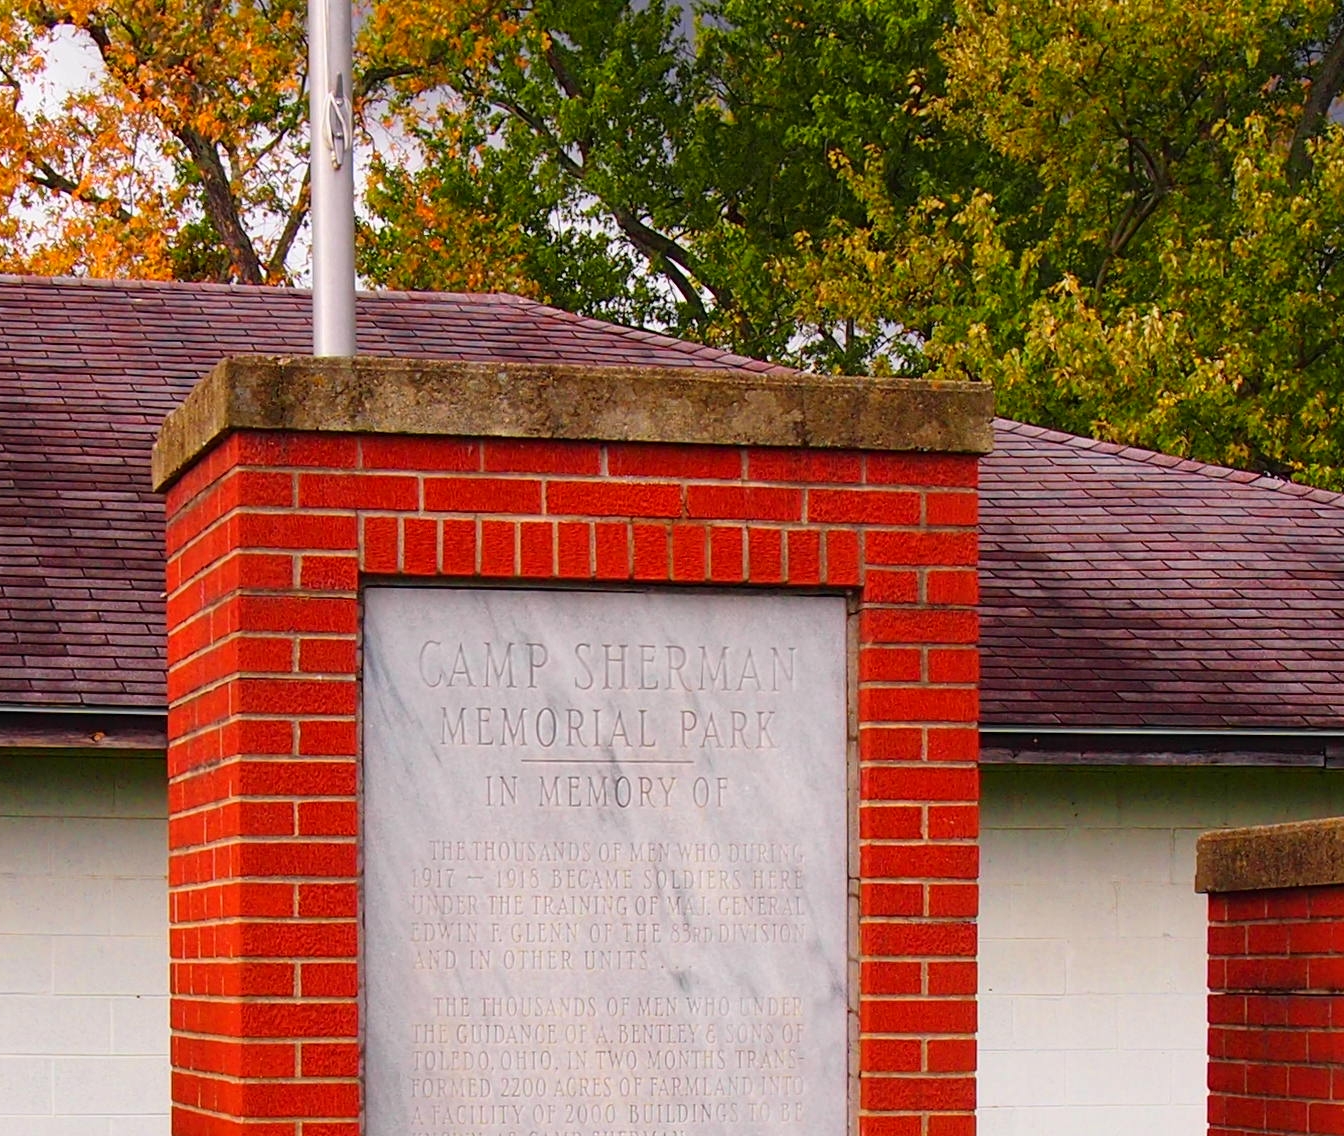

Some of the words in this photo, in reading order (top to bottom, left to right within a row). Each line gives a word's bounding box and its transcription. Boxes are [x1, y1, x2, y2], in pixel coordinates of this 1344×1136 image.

[419, 640, 549, 690] CAMP
[574, 642, 797, 693] SHERMAN
[440, 707, 657, 749] MEMORIAL
[679, 709, 779, 750] PARK
[484, 776, 518, 807] IN
[538, 776, 677, 808] MEMORY
[693, 777, 728, 808] OF
[429, 841, 466, 861] THE
[473, 841, 591, 862] THOUSANDS
[599, 843, 621, 862] OF
[630, 842, 669, 862] MEN
[677, 843, 720, 862] WHO
[728, 843, 804, 864] DURING
[412, 868, 455, 888] 1917
[496, 868, 540, 889] 1918
[552, 868, 632, 889] BECAME
[644, 870, 742, 890] SOLDIERS
[753, 870, 804, 889] HERE
[412, 895, 478, 915] UNDER
[489, 896, 524, 915] THE
[532, 896, 627, 915] TRAINING
[635, 896, 658, 915] OF
[667, 896, 711, 916] MAJ.
[718, 896, 805, 916] GENERAL
[410, 923, 478, 943] EDWIN
[492, 923, 502, 943] F.
[511, 923, 577, 943] GLENN
[589, 923, 613, 943] OF
[623, 923, 661, 943] THE
[719, 923, 805, 943] DIVISION
[414, 951, 456, 970] AND
[470, 951, 490, 970] IN
[503, 951, 573, 970] OTHER
[584, 951, 648, 970] UNITS
[433, 997, 470, 1016] THE
[480, 997, 596, 1017] THOUSANDS
[607, 997, 630, 1016] OF
[637, 997, 677, 1016] MEN
[686, 997, 730, 1016] WHO
[739, 997, 804, 1016] UNDER
[412, 1024, 448, 1044] THE
[456, 1024, 557, 1044] GUIDANCE
[565, 1024, 587, 1044] OF
[619, 1024, 699, 1043] BENTLEY
[726, 1024, 774, 1043] SONS
[782, 1024, 804, 1043] OF
[413, 1051, 494, 1072] TOLEDO,
[568, 1050, 587, 1069] IN
[596, 1050, 637, 1070] TWO
[647, 1050, 726, 1069] MONTHS
[411, 1078, 491, 1098] FORMED
[500, 1078, 546, 1098] 2200
[555, 1077, 612, 1097] ACRES
[619, 1077, 642, 1097] OF
[650, 1077, 753, 1097] FARMLAND
[761, 1077, 804, 1096] INTO
[411, 1105, 424, 1125] A
[432, 1104, 525, 1125] FACILITY
[532, 1104, 556, 1124] OF
[565, 1104, 616, 1124] 2000
[629, 1103, 738, 1123] BUILDINGS
[748, 1103, 770, 1122] TO
[781, 1102, 804, 1122] BE
